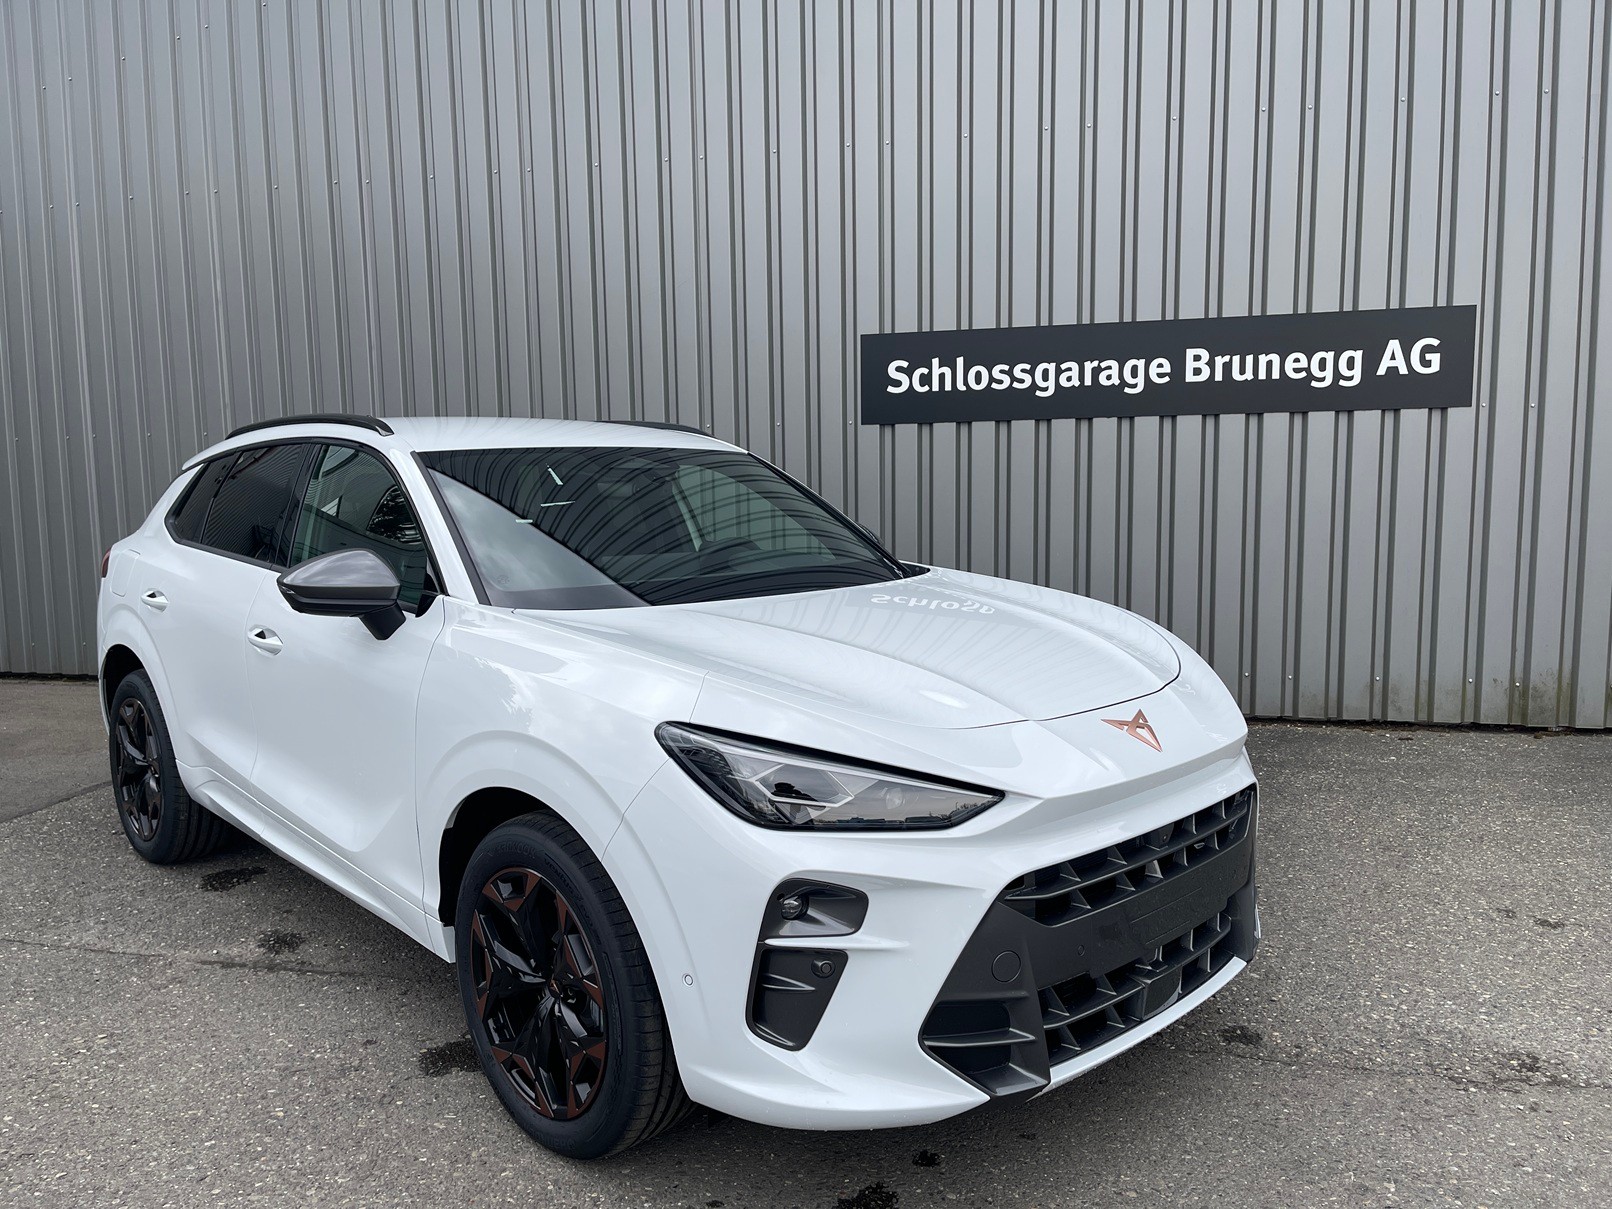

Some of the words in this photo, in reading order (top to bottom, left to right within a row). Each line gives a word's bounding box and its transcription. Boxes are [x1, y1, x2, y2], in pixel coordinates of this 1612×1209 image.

[886, 355, 1172, 398] Schlossgarage
[1185, 347, 1364, 388] Brunegg
[1375, 337, 1441, 376] AG
